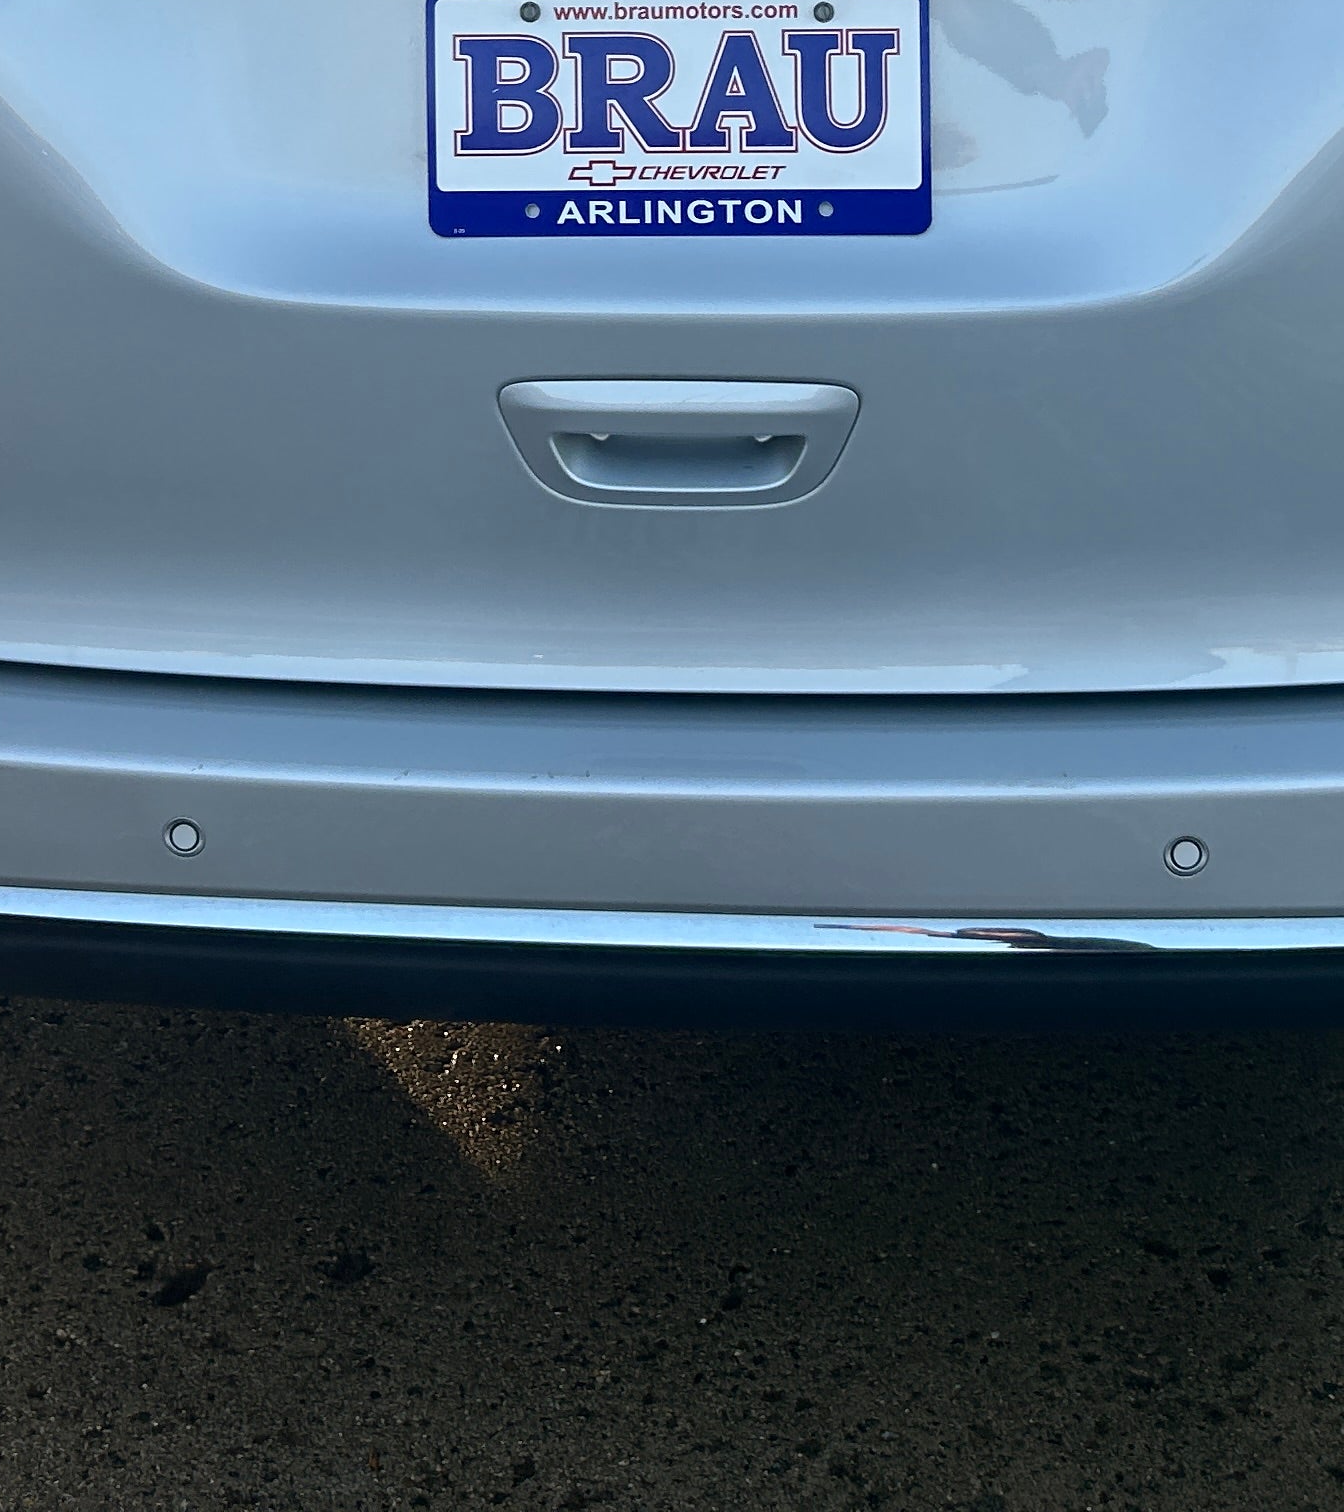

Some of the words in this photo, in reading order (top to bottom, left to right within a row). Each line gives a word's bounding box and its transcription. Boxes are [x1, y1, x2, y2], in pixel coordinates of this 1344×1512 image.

[554, 2, 798, 20] www.braumotors.com
[453, 29, 900, 156] BRAU
[638, 164, 786, 180] CHEVROLET
[557, 199, 802, 224] ARLINGTON
